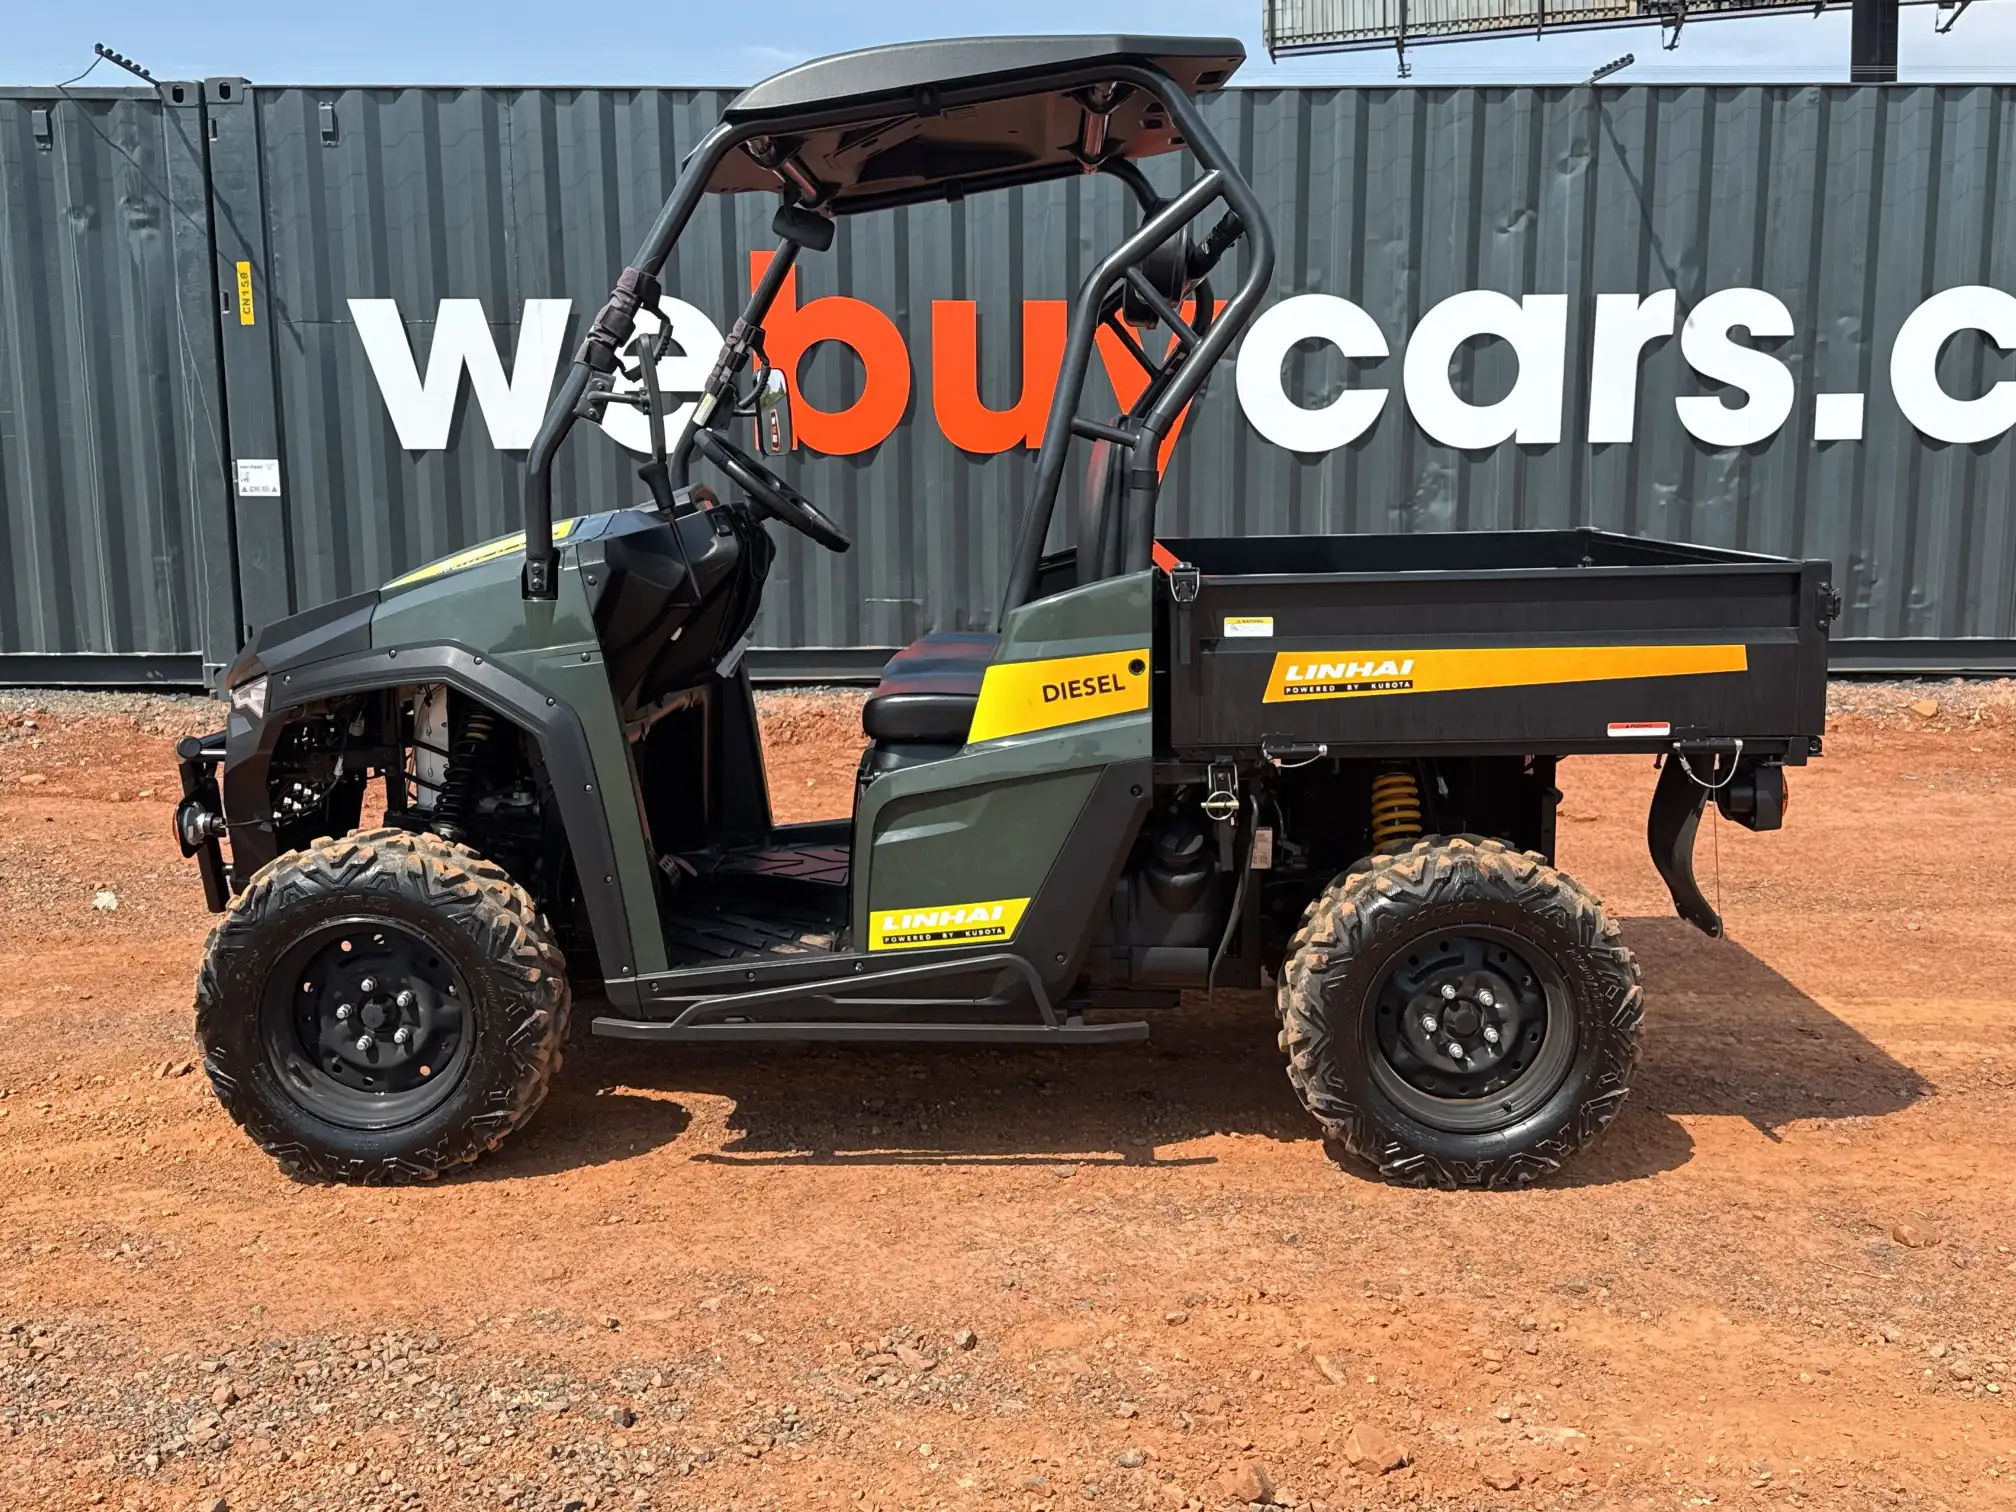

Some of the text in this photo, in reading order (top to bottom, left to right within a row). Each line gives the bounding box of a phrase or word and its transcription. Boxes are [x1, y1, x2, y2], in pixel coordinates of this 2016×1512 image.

[347, 251, 2016, 484] webucars.c
[1285, 660, 1414, 681] LINHAI
[1042, 673, 1127, 703] DIESEL
[1286, 682, 1411, 694] POWERED BY KUBOTA
[883, 905, 1004, 931] LINHAI
[885, 934, 932, 943] POWERED
[965, 928, 1003, 937] KUBOTA
